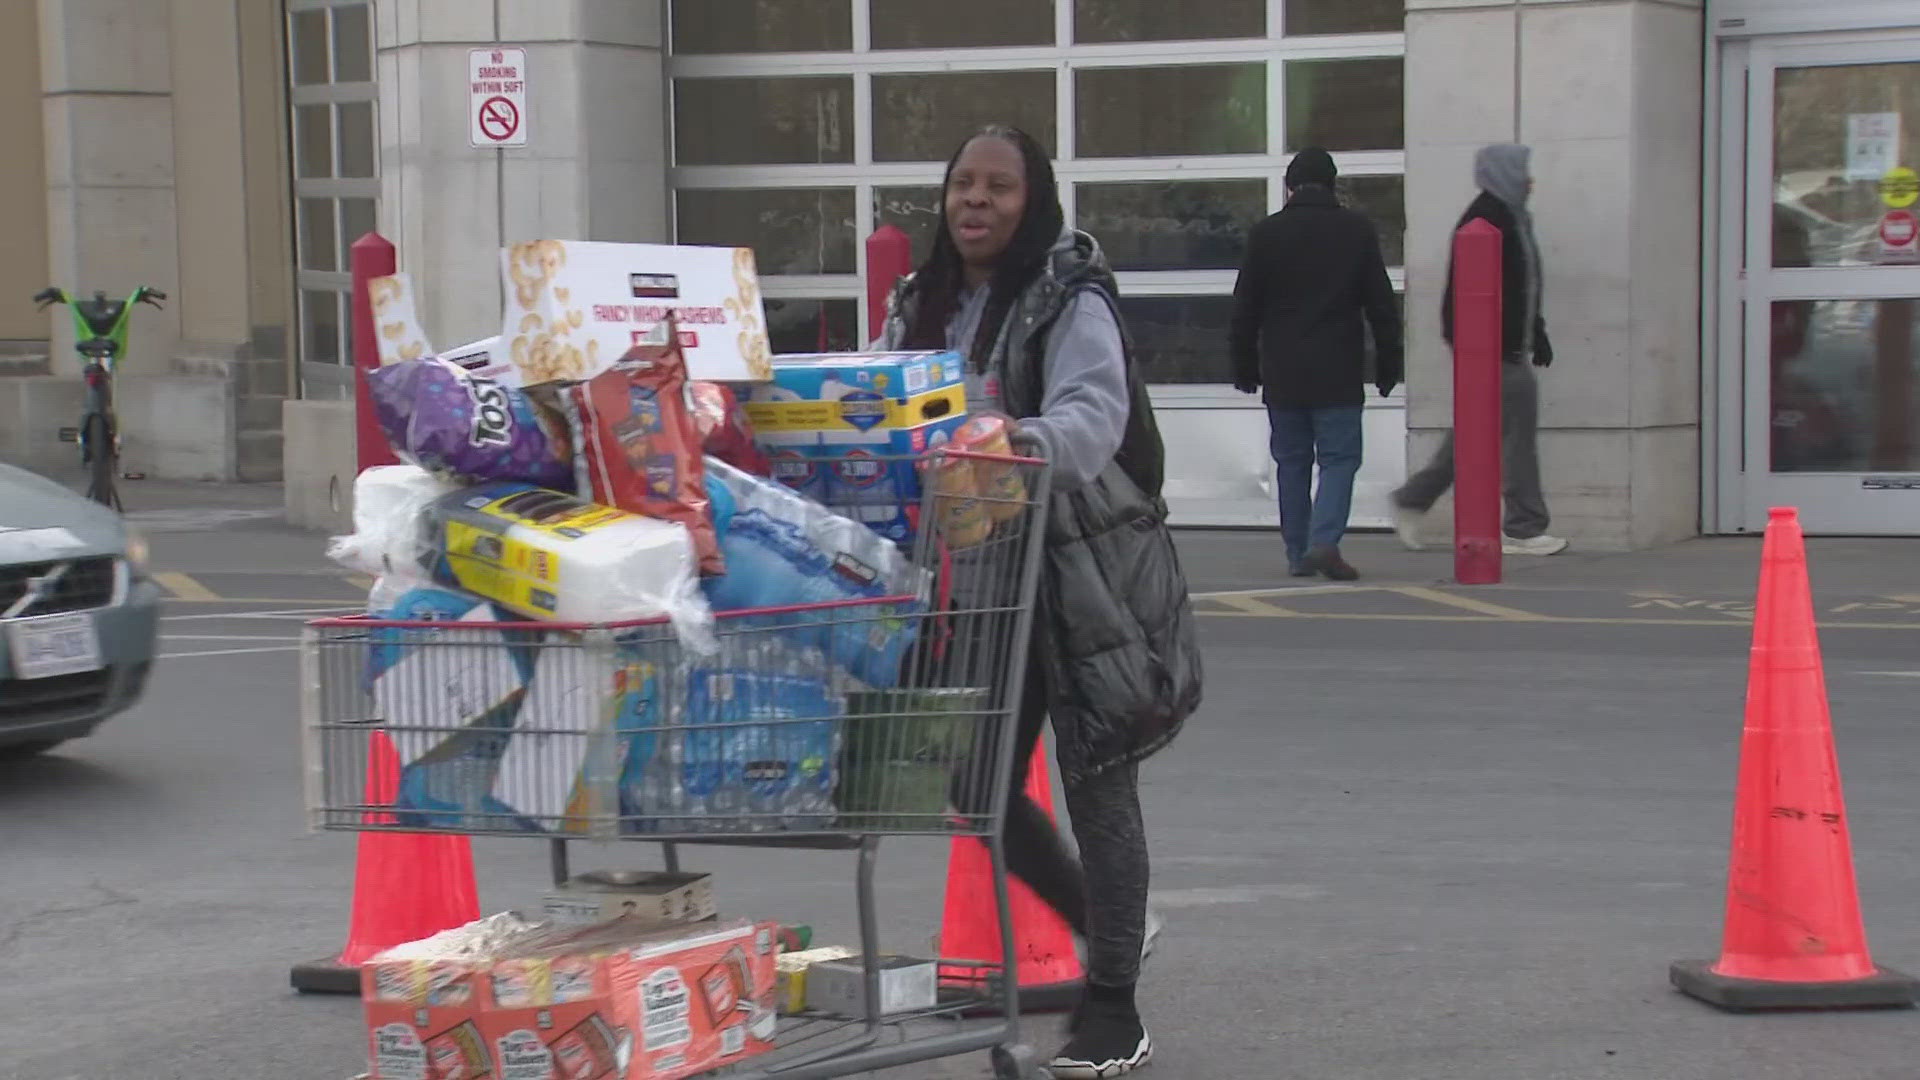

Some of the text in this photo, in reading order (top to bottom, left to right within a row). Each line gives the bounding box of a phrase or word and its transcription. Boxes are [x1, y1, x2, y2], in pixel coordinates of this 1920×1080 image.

[491, 52, 504, 65] NO
[479, 67, 517, 78] SMOKING
[472, 82, 502, 94] WITHIN
[592, 304, 629, 322] FANCY
